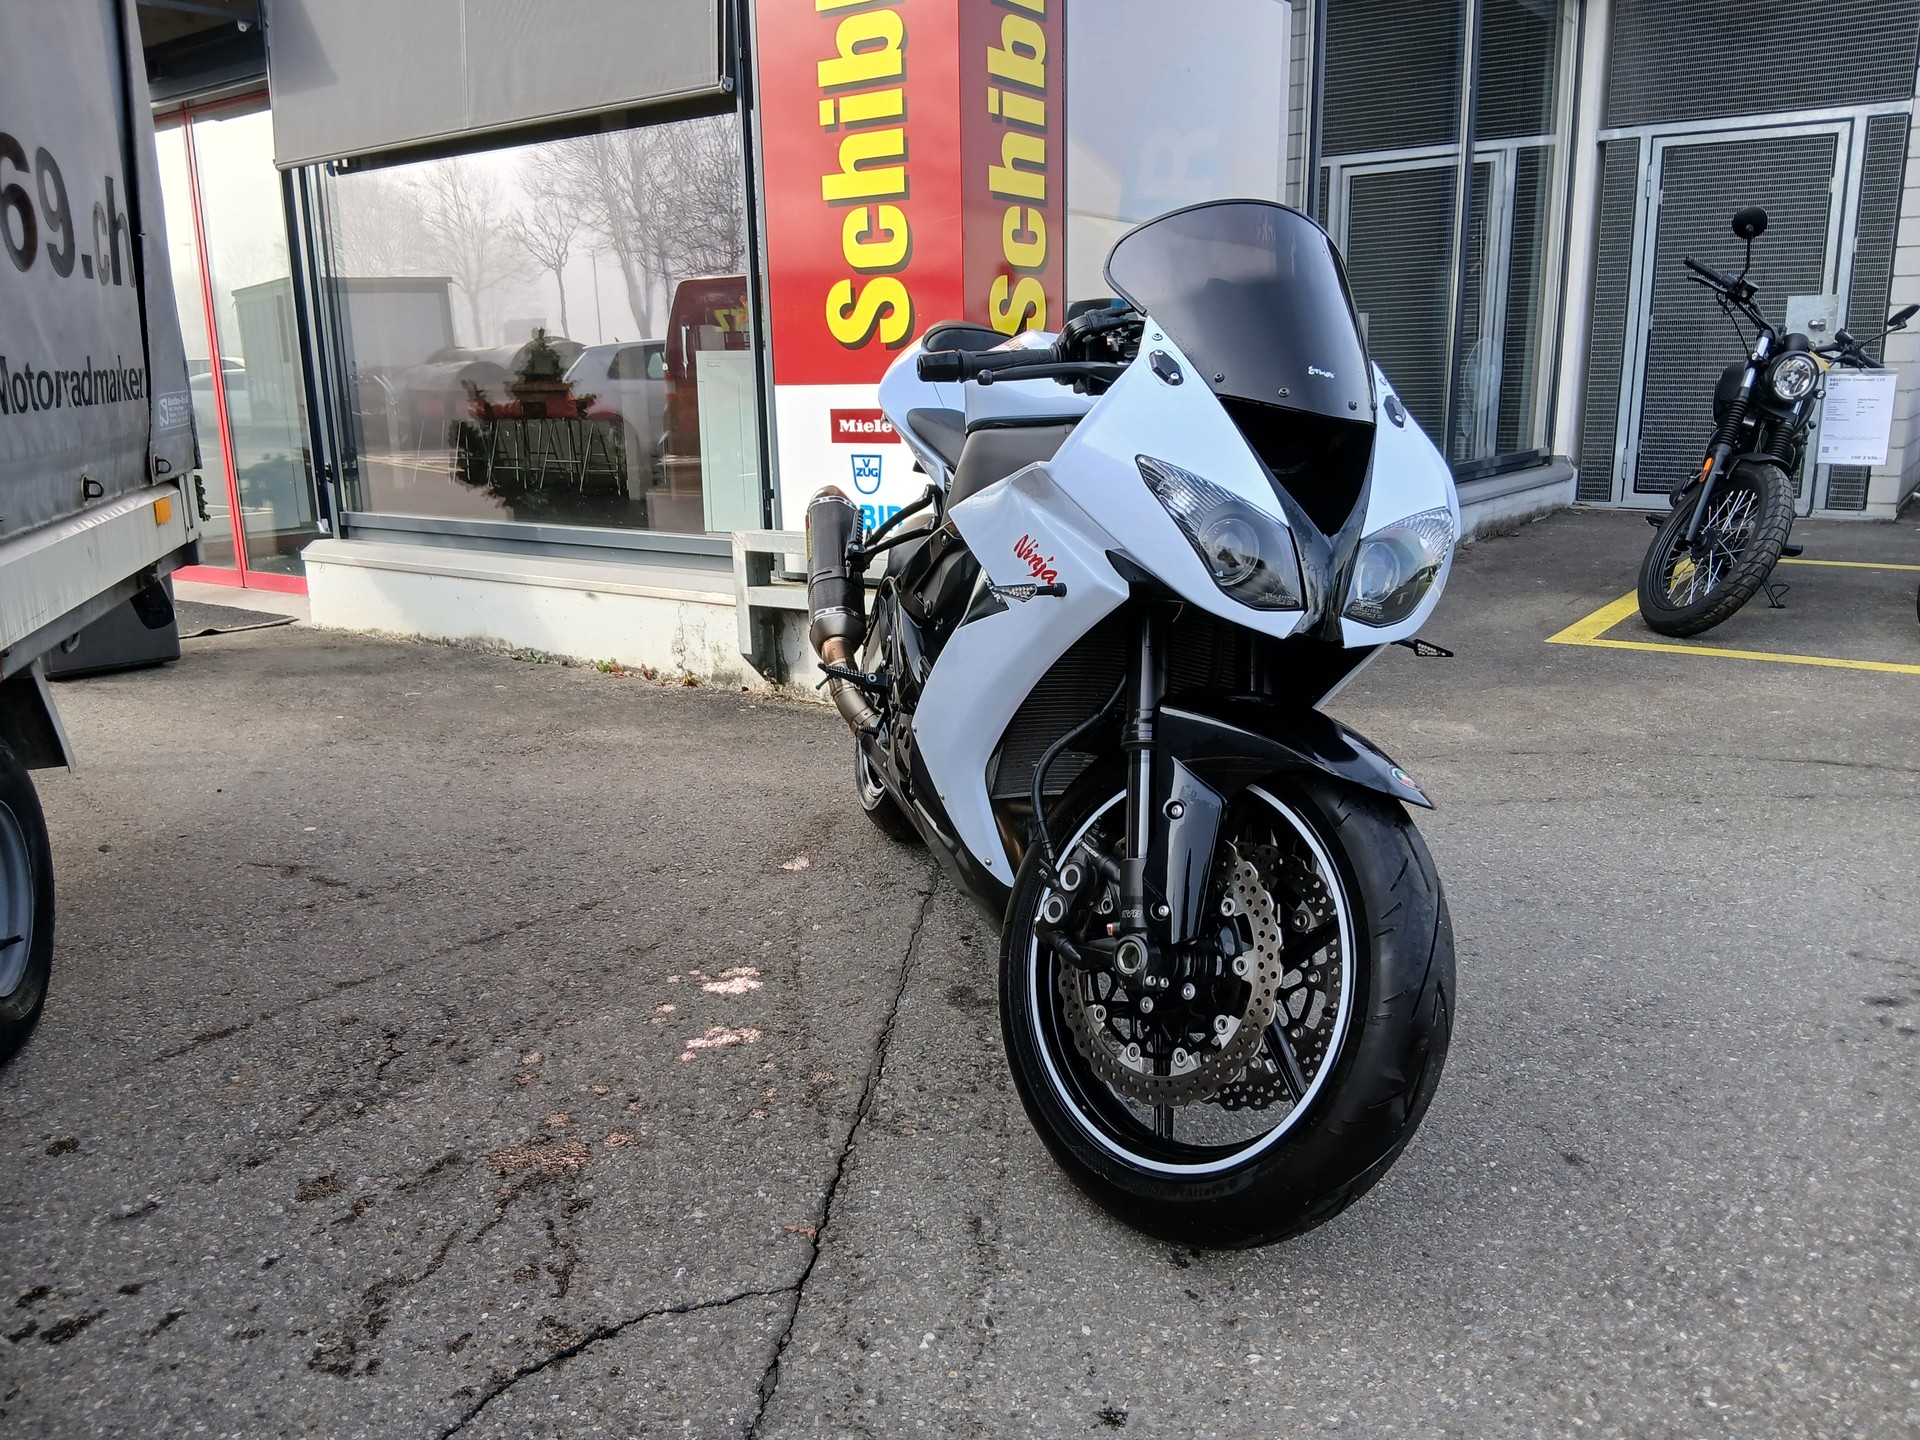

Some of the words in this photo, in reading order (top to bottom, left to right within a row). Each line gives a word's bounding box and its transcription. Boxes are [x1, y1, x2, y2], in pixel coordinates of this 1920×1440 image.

[986, 0, 1047, 337] Schib
[838, 419, 893, 433] Miele
[861, 458, 871, 468] V
[855, 467, 879, 478] ZUG
[1013, 533, 1058, 588] Ninja
